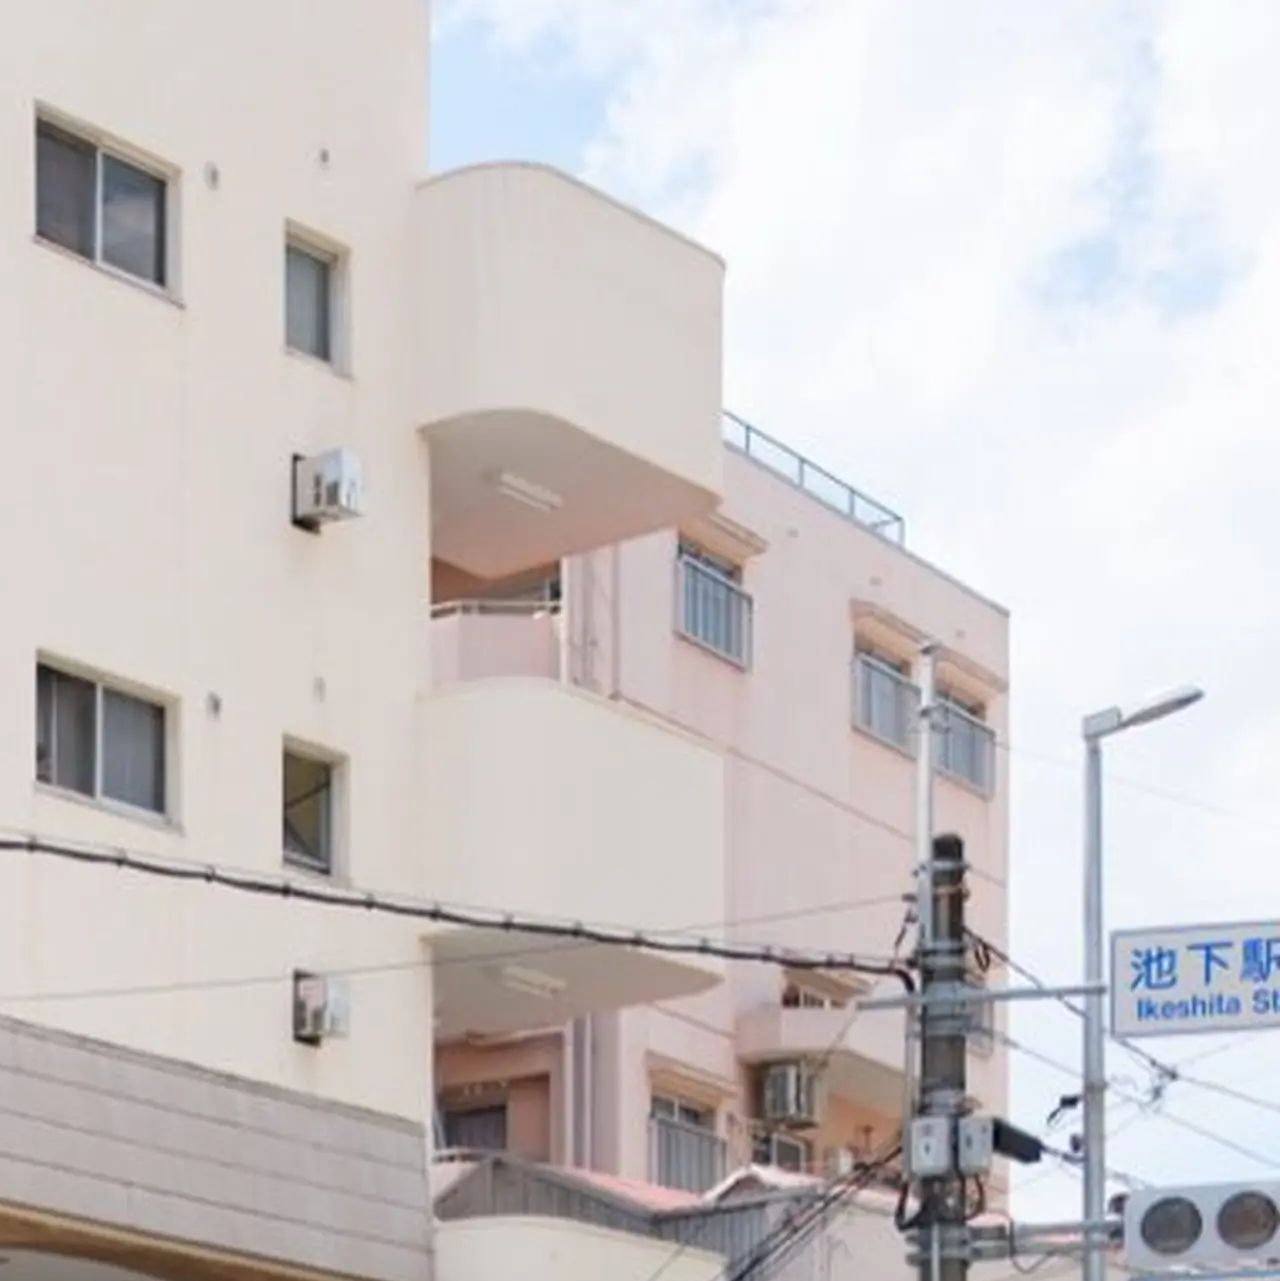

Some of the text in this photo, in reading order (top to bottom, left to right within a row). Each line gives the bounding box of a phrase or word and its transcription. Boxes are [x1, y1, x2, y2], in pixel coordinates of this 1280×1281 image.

[1130, 937, 1280, 990] 池下駅
[1137, 992, 1242, 1021] Ikeshita
